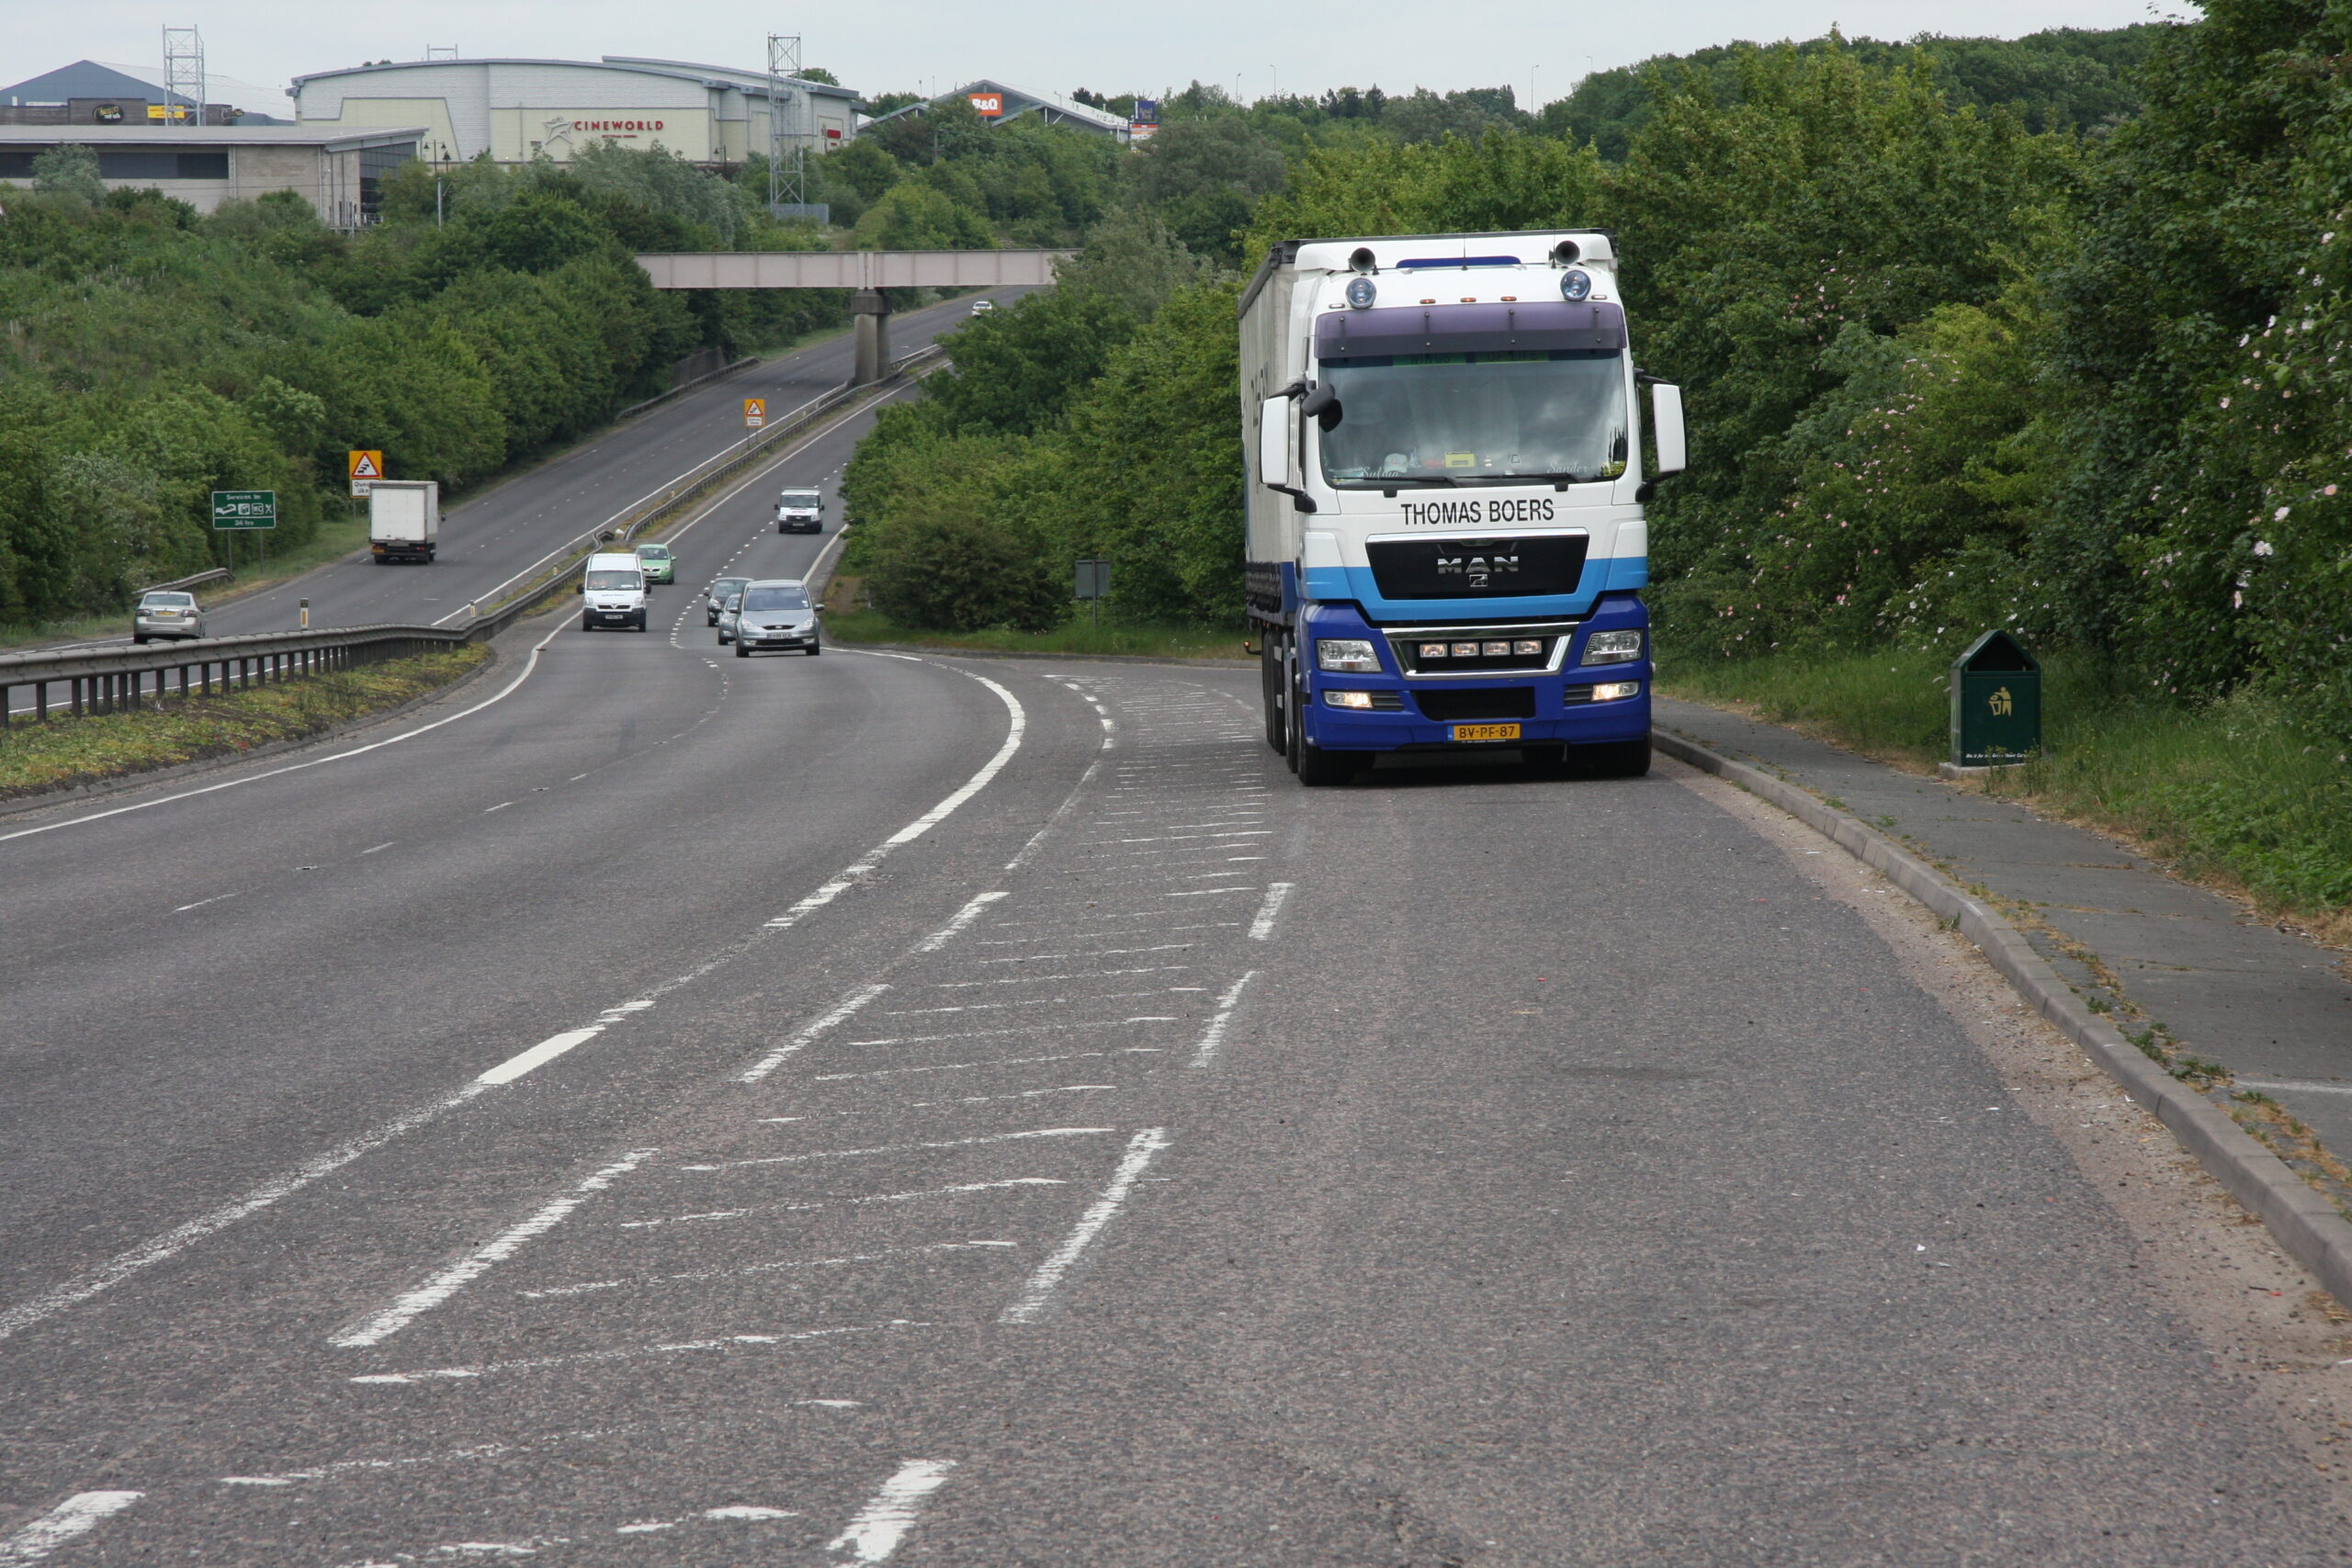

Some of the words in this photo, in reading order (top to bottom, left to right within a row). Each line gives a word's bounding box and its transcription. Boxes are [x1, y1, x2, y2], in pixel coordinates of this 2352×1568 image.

[574, 120, 663, 130] CINEWORLD
[1547, 461, 1589, 474] Sander
[1400, 501, 1482, 525] THOMAS
[1489, 499, 1555, 523] BOERS
[1437, 556, 1519, 574] MAN
[1459, 726, 1515, 739] BV-PF-87
